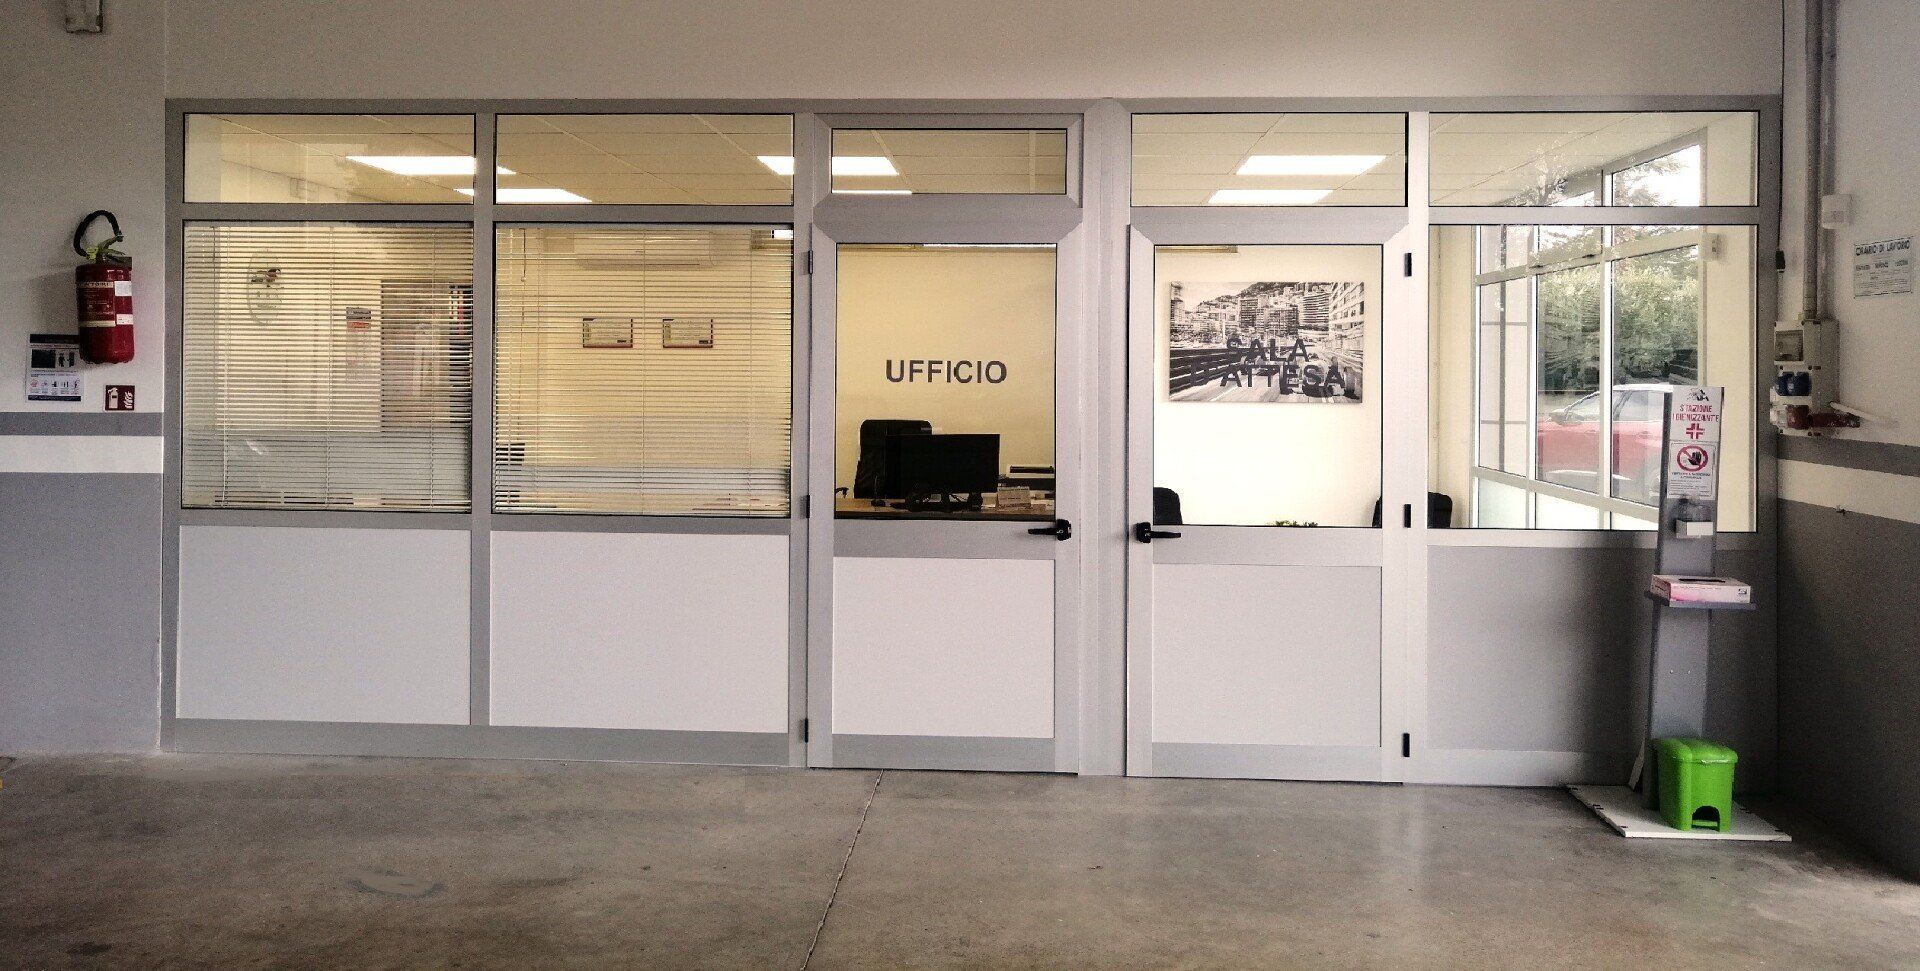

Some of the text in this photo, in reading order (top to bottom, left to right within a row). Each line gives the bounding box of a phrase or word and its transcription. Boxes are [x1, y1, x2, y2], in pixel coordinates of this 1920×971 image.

[1878, 243, 1884, 253] DI
[1886, 239, 1910, 252] LAVORO
[1226, 338, 1310, 362] SALA
[886, 359, 1007, 384] UFFICIO
[1679, 404, 1713, 413] STAZIONE
[1673, 413, 1719, 422] IGIENIZZANTE
